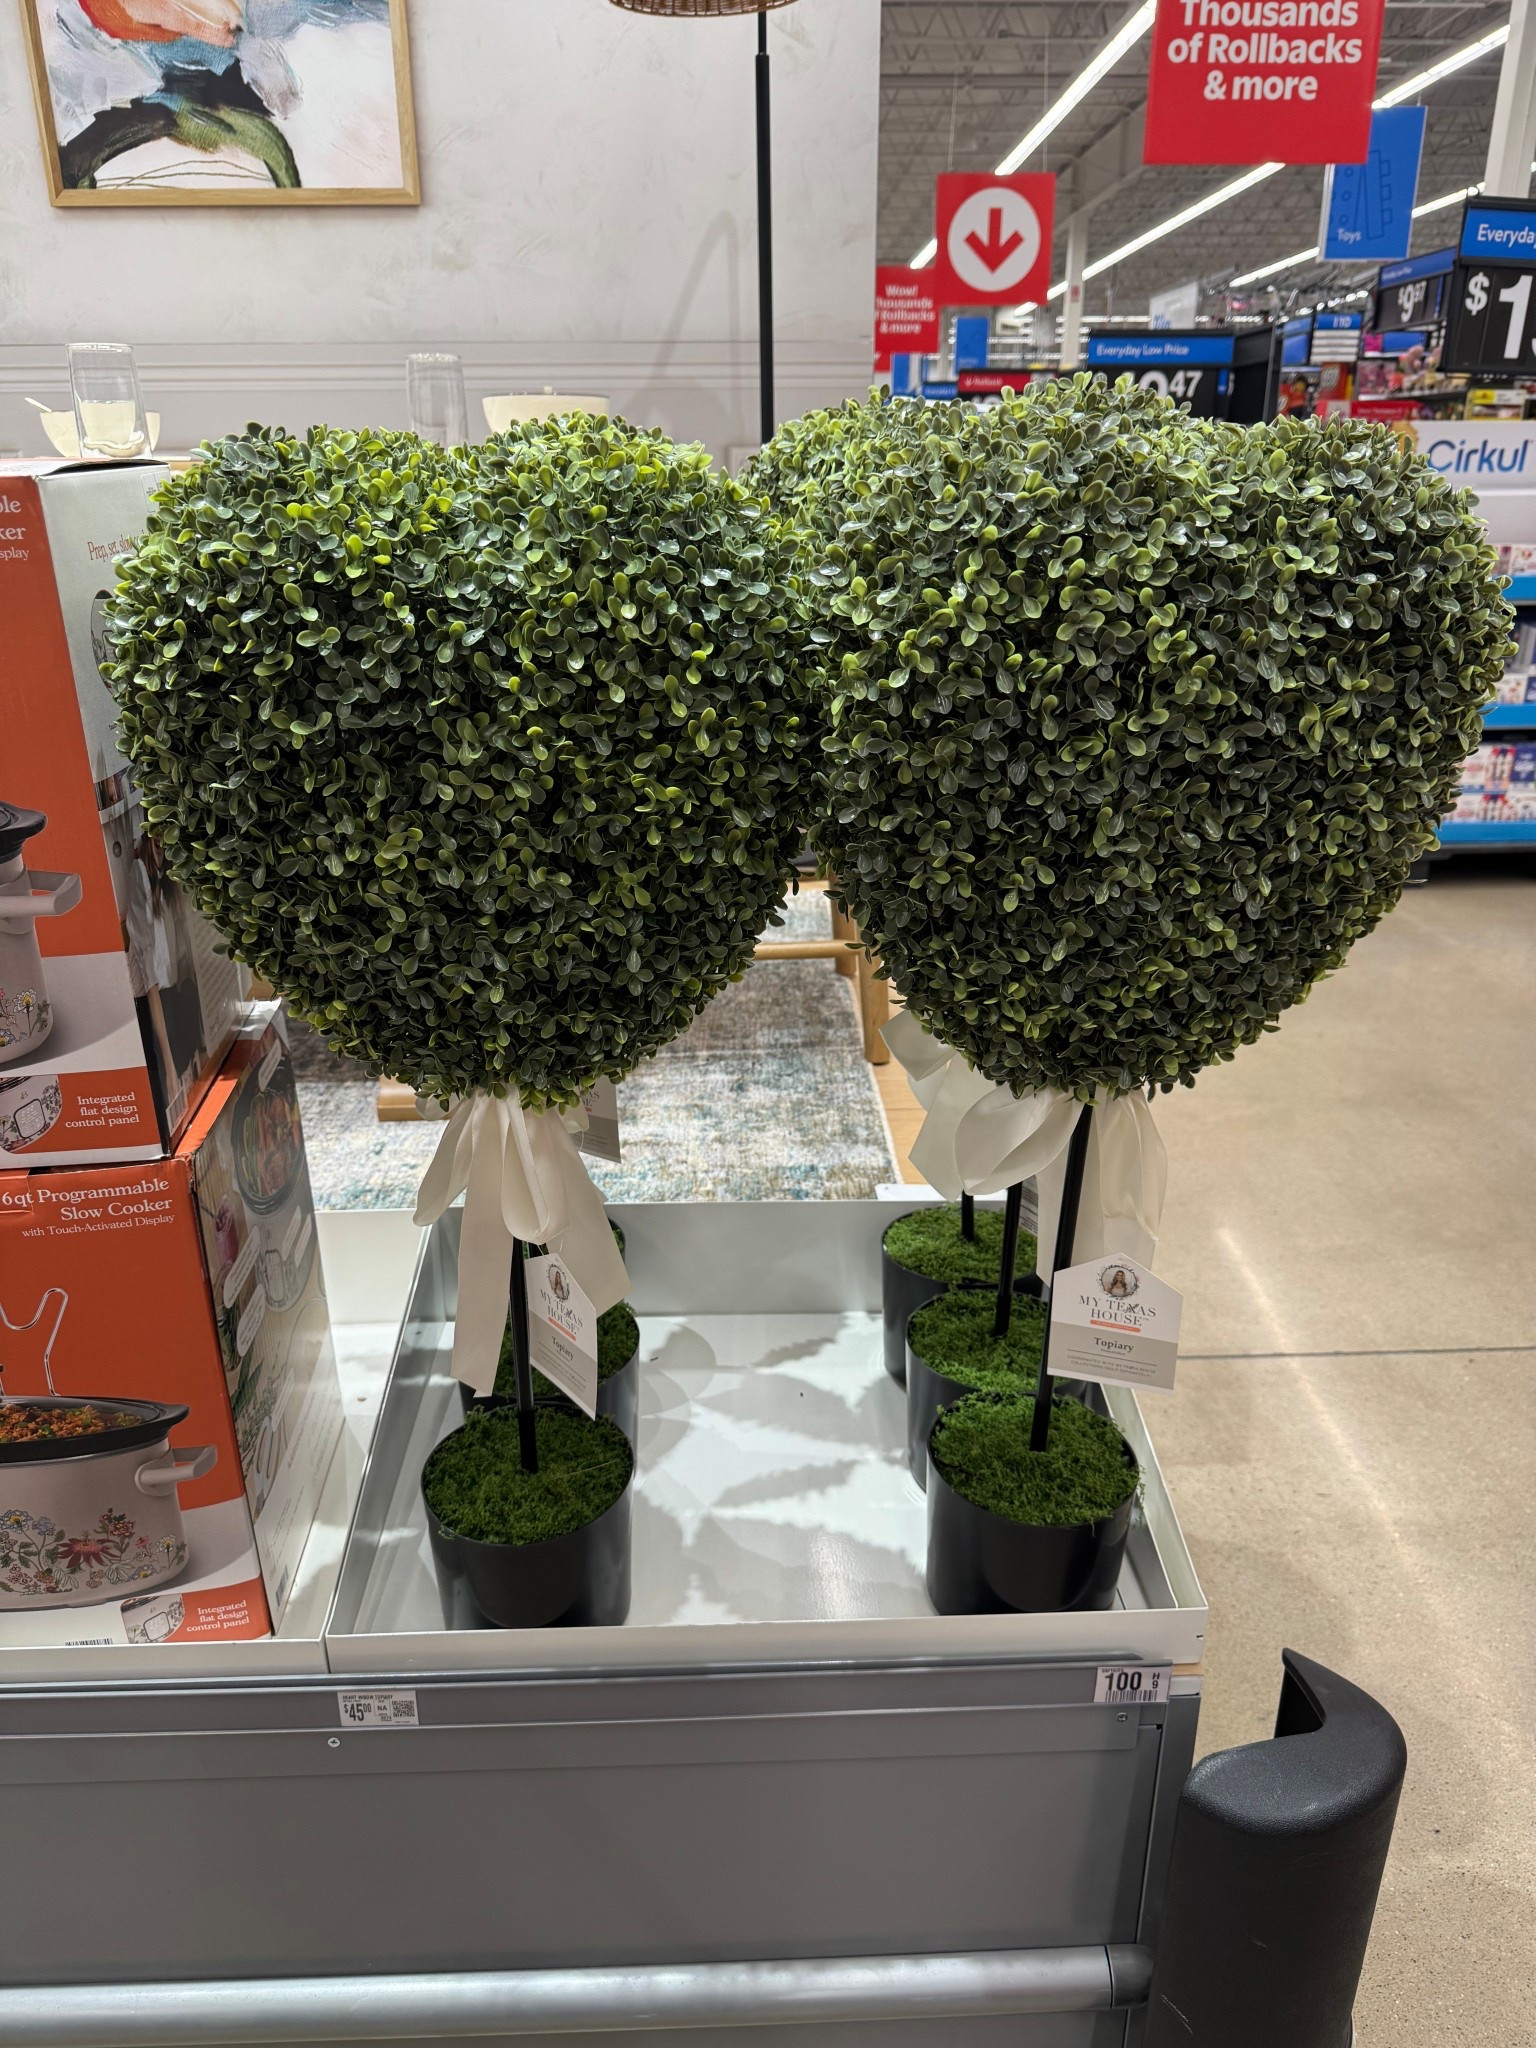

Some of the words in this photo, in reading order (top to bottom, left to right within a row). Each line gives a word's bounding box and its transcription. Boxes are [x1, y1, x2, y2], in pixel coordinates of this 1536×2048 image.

[1179, 0, 1359, 27] Thousands
[1167, 32, 1204, 63] of
[1207, 32, 1363, 64] Rollbacks
[1203, 69, 1227, 101] &
[1231, 74, 1319, 101] more
[1337, 228, 1361, 245] Toys
[876, 297, 934, 309] housands
[1096, 344, 1142, 358] Everyday
[1143, 344, 1162, 356] Low
[1164, 344, 1190, 356] Price
[1427, 439, 1529, 473] Cirkul
[87, 541, 108, 563] Prep,
[77, 1092, 136, 1106] Integrated
[80, 1106, 99, 1116] flat
[101, 1104, 138, 1117] design
[65, 1117, 105, 1128] control
[108, 1114, 140, 1127] panel
[36, 1178, 170, 1204] Programmable
[60, 1206, 103, 1221] Slow
[108, 1199, 173, 1216] Cooker
[22, 1228, 45, 1238] with
[47, 1219, 133, 1235] Touch-Activated
[135, 1213, 175, 1227] Display
[555, 1300, 583, 1328] TEXAS
[1079, 1295, 1100, 1308] MY
[1106, 1299, 1156, 1318] TEXAS
[551, 1335, 575, 1361] Topiary
[1093, 1336, 1134, 1353] Topiary
[197, 1600, 247, 1615] Integrated
[199, 1614, 215, 1623] flat
[217, 1610, 248, 1622] design
[186, 1621, 221, 1632] control
[223, 1616, 250, 1629] panel
[1104, 1671, 1142, 1691] 100
[1152, 1672, 1160, 1680] H
[1152, 1680, 1159, 1689] 9
